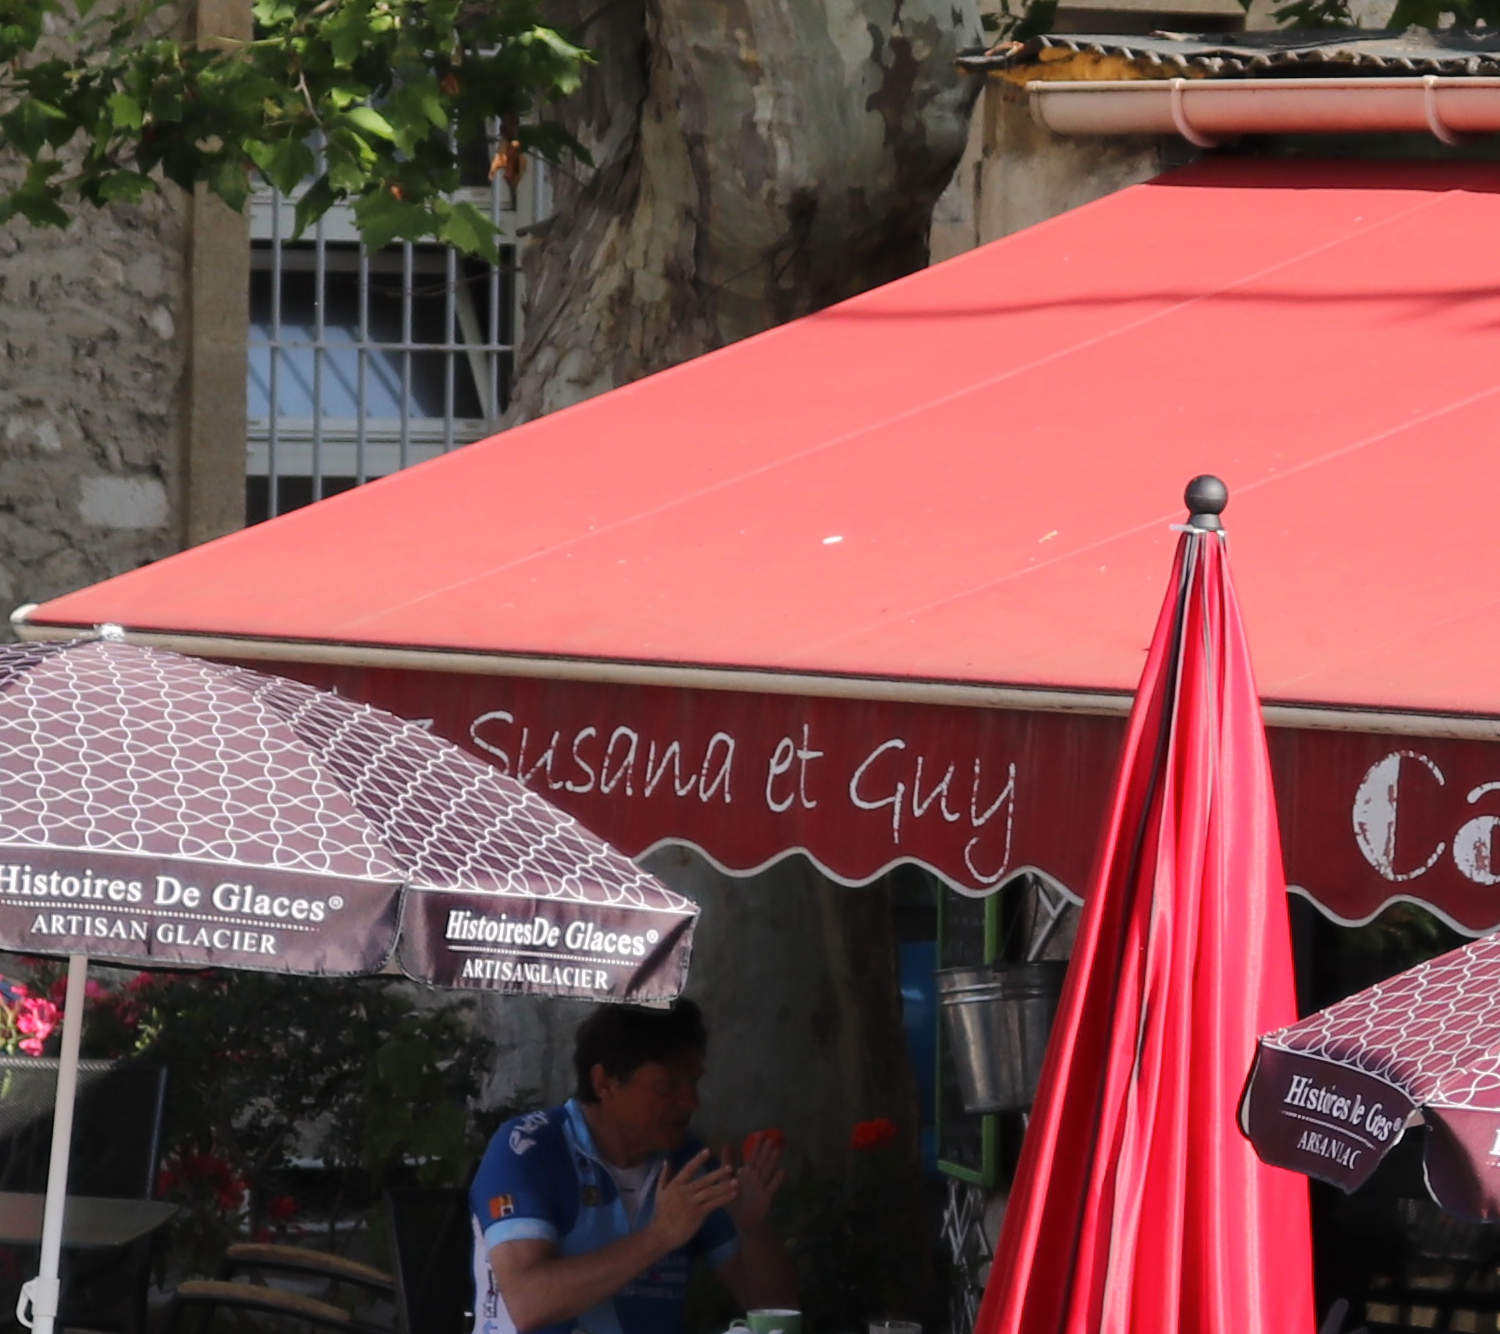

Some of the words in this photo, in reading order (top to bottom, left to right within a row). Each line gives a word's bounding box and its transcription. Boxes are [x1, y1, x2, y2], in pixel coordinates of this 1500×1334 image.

[468, 711, 733, 805] Susana
[766, 723, 824, 813] et
[849, 739, 1017, 885] Guy
[154, 876, 200, 907] De
[31, 915, 149, 941] ARTISAN
[156, 924, 276, 955] GLACIER
[446, 910, 532, 944] Histoires
[532, 917, 560, 947] De
[462, 958, 533, 983] ARTISAN
[530, 964, 609, 990] GLACIER
